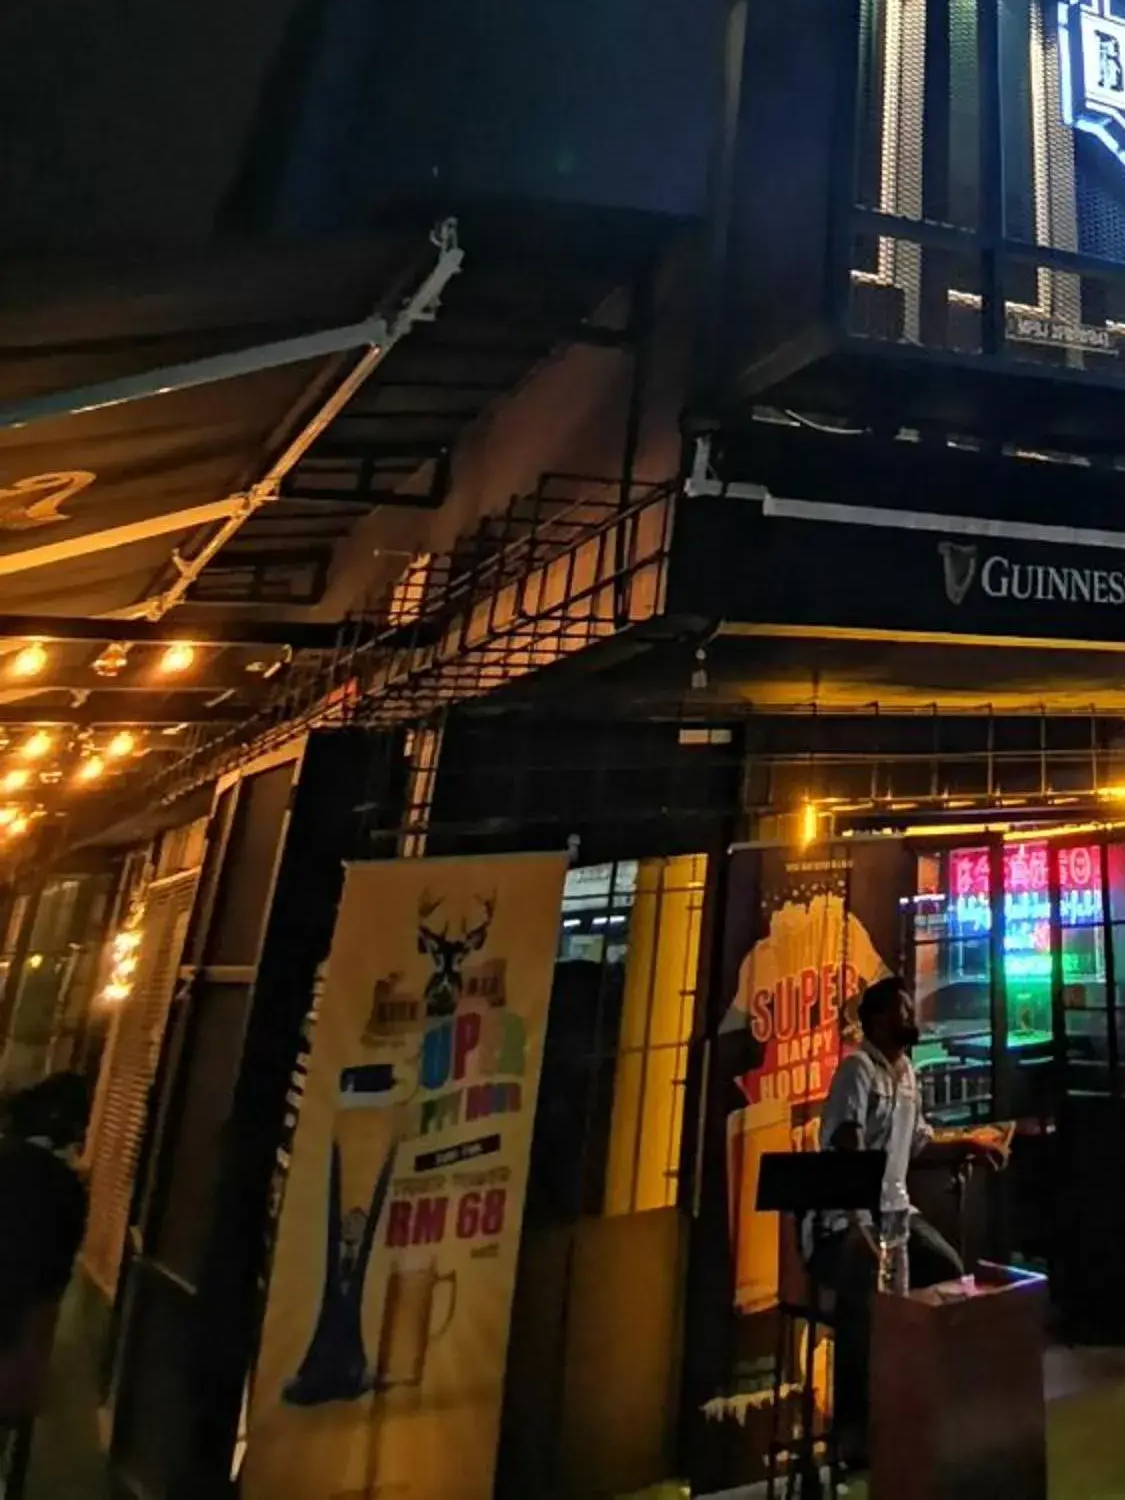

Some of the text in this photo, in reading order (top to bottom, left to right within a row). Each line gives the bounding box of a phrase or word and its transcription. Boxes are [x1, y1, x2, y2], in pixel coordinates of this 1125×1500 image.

[751, 963, 860, 1042] SUPER
[776, 1028, 833, 1067] HAPPY
[759, 1061, 822, 1101] HOUR
[385, 1188, 507, 1248] RM 68
